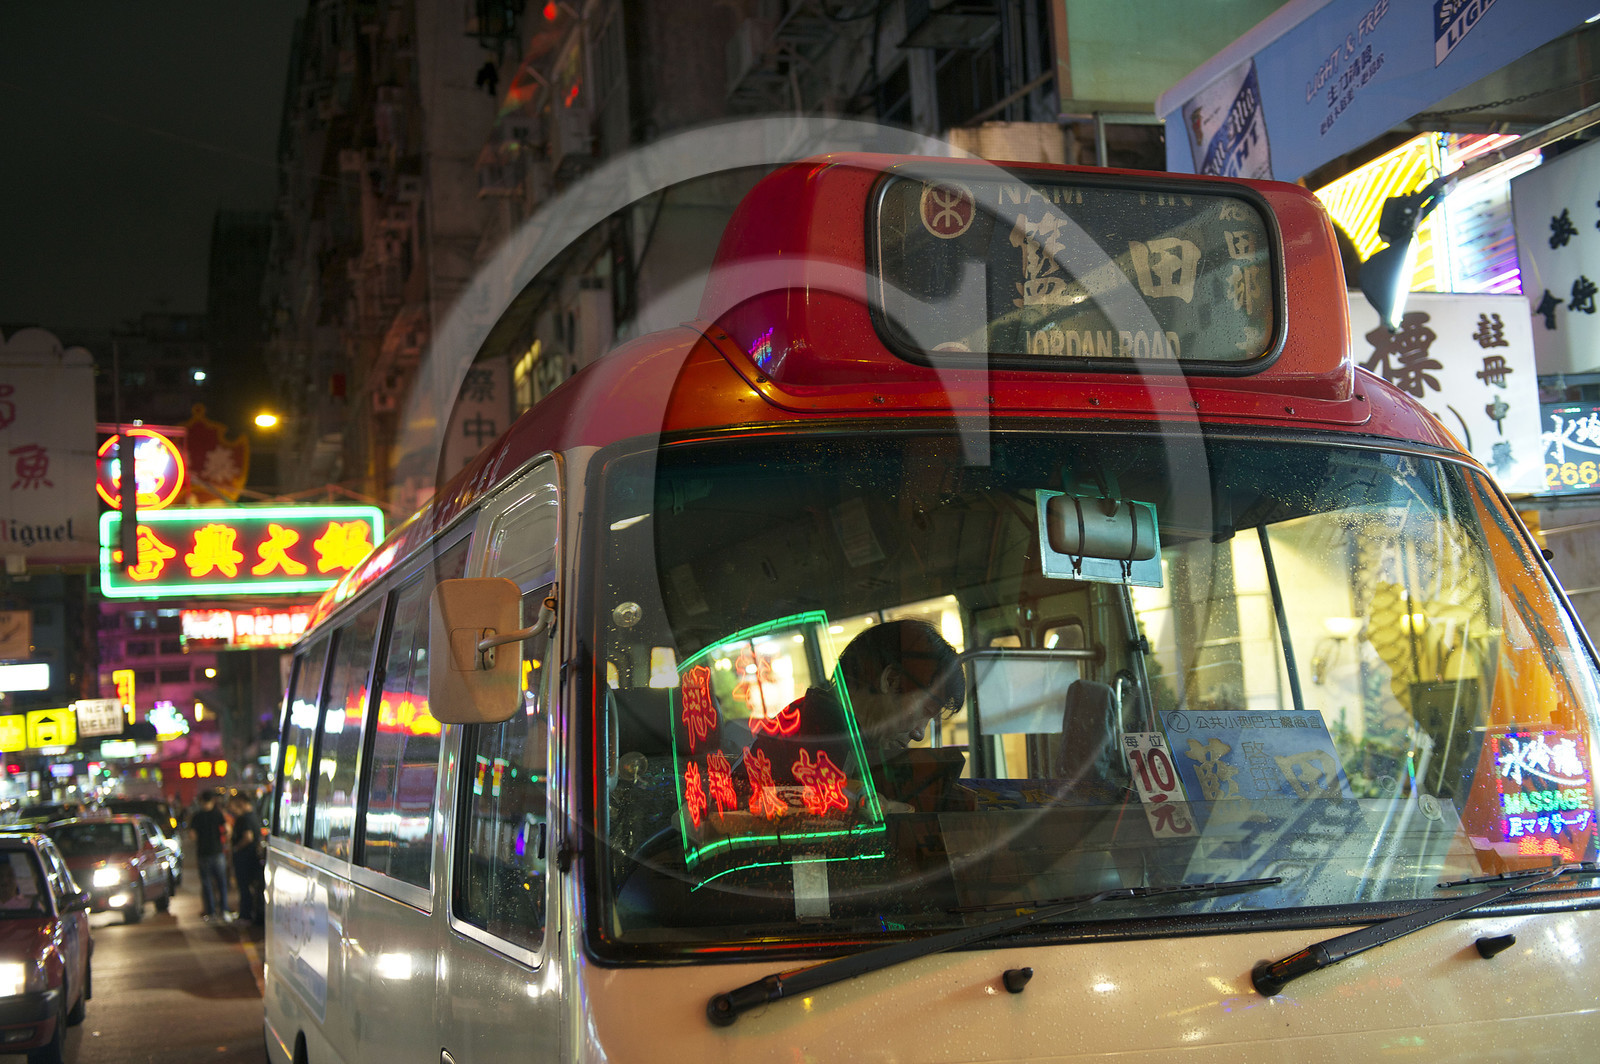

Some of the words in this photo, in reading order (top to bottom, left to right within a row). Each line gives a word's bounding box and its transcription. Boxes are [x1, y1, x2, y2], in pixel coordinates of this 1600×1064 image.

[1118, 331, 1181, 360] ROAD
[1545, 461, 1600, 486] 266
[0, 517, 75, 547] iguel
[1129, 747, 1176, 792] 10
[1148, 793, 1192, 834] 元
[1503, 788, 1591, 815] MASSAGE
